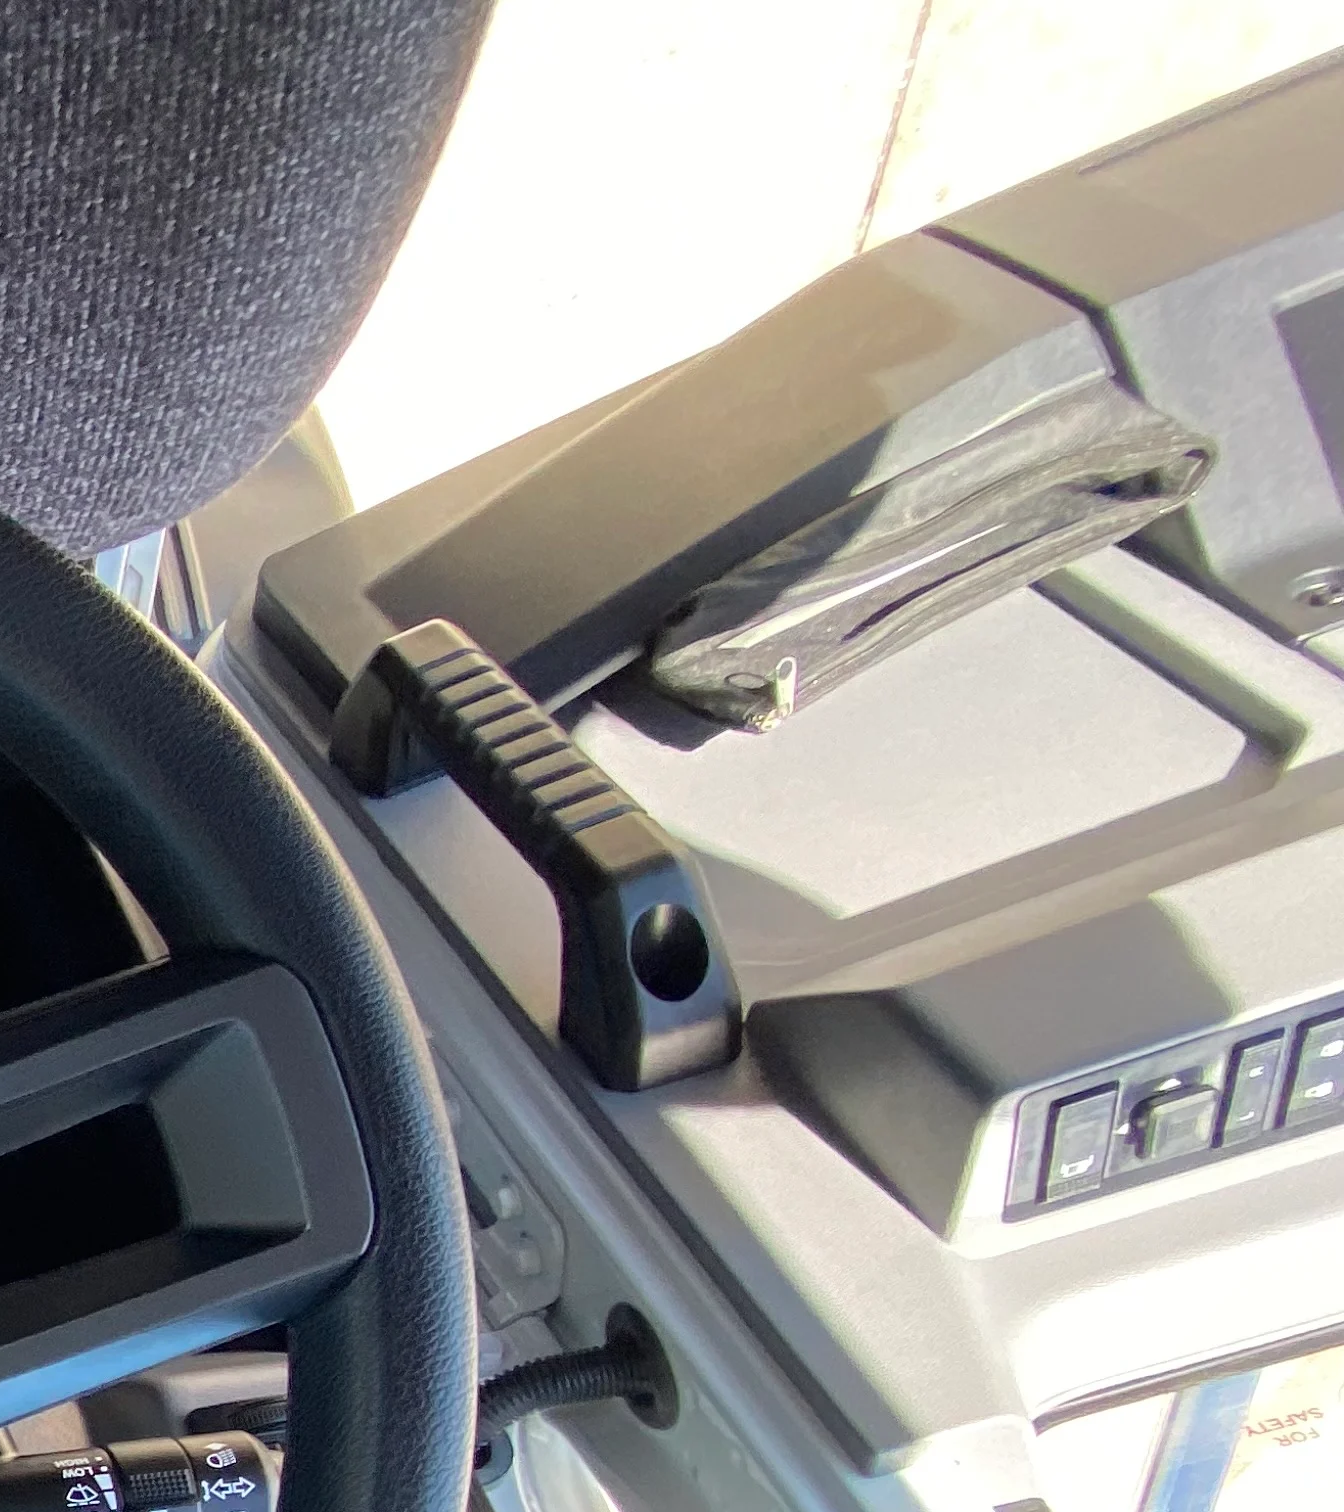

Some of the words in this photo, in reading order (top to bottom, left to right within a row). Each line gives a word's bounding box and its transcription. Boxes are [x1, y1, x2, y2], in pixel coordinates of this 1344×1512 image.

[1240, 1407, 1324, 1438] SAFETY
[1272, 1426, 1320, 1447] FOR
[62, 1466, 94, 1479] LOW
